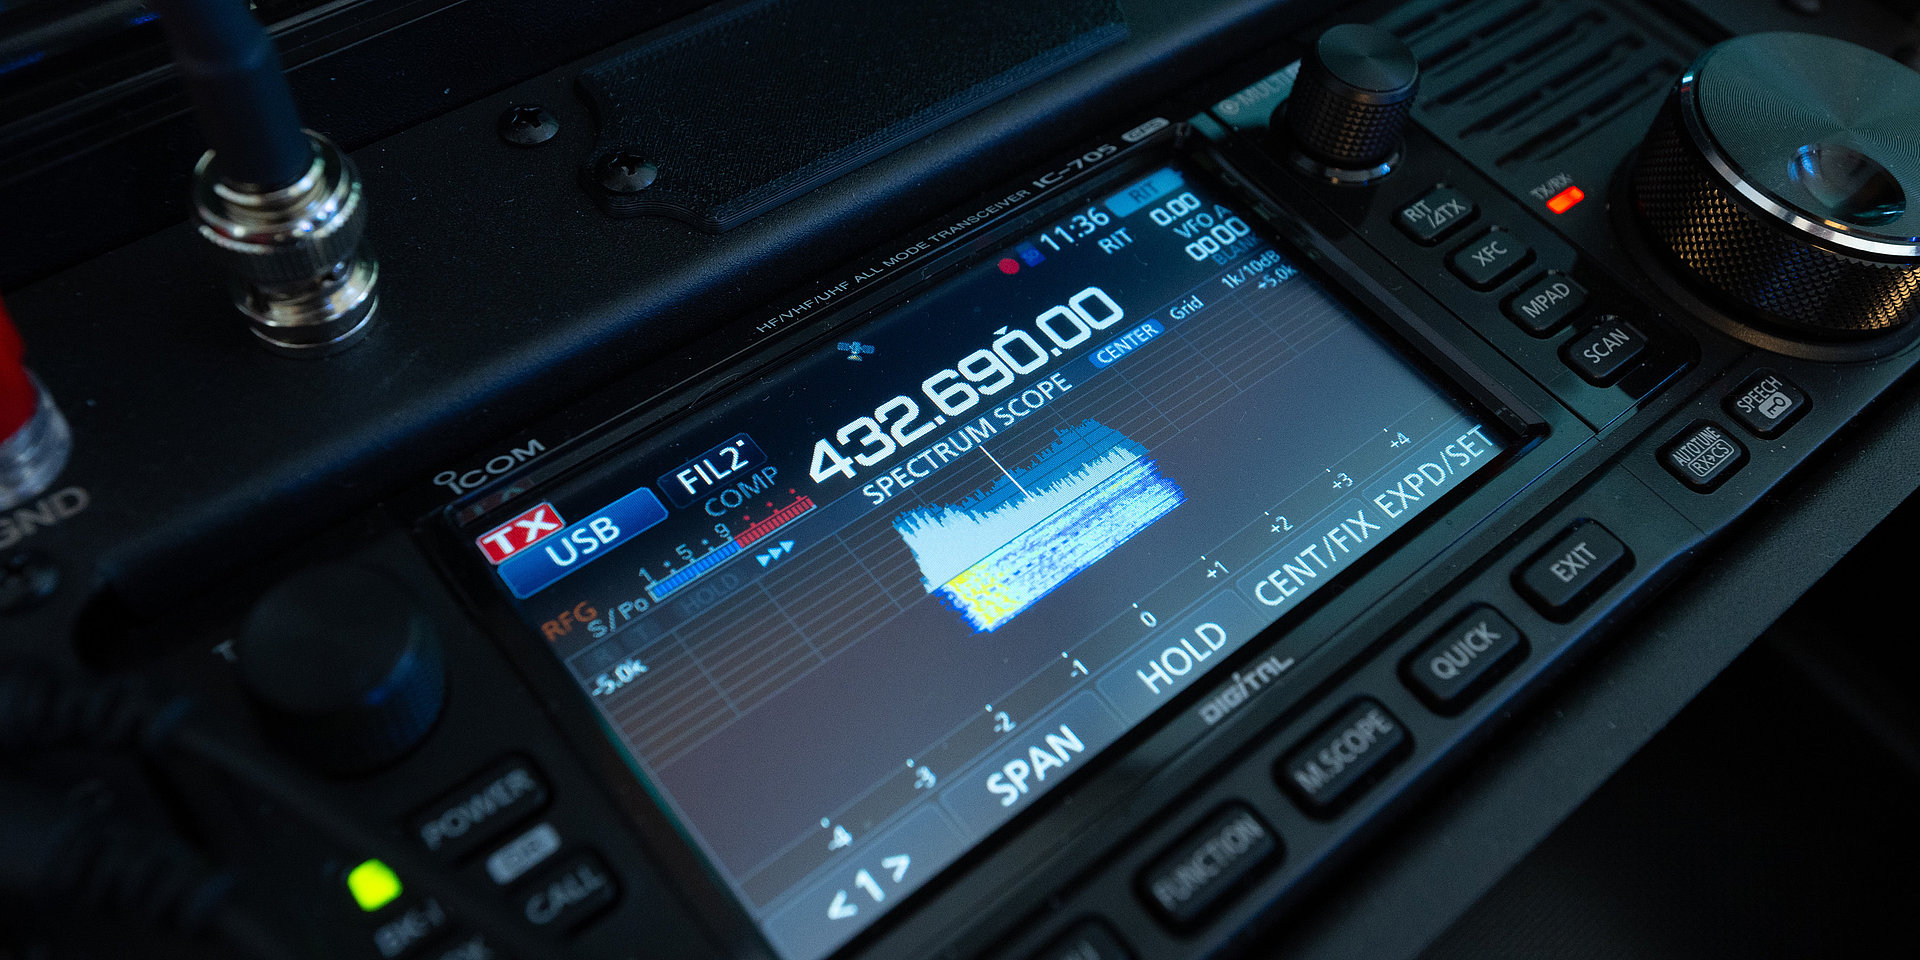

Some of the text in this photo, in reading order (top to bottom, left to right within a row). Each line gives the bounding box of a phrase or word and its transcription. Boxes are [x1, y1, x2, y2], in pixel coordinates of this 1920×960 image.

[1128, 181, 1161, 204] RIT
[1402, 199, 1433, 223] RIT
[756, 143, 1118, 333] HF/VHF/UHF ALL MODE TRANSCEIVER IC-705
[1040, 206, 1110, 251] 11:36
[1098, 192, 1201, 255] RIT 0.00
[1173, 204, 1232, 239] VFO A
[1211, 232, 1261, 266] BLANK
[1221, 249, 1281, 289] 1k/10dB
[1471, 240, 1508, 267] XFC
[1169, 295, 1204, 322] Grid
[1521, 282, 1571, 319] MPAD
[1095, 322, 1159, 365] CENTER
[1583, 327, 1630, 364] SCAN
[809, 287, 1124, 484] 432.690.00
[1736, 375, 1783, 413] SPEECH
[862, 372, 1073, 505] SPECTRUM SCOPE
[1671, 426, 1721, 467] AUTOTUNE
[704, 465, 778, 517] COMP
[1373, 424, 1494, 519] EXPD/SET
[482, 509, 560, 555] TX
[544, 517, 620, 567] USB
[1071, 659, 1089, 677] -1
[1140, 611, 1158, 628] 0
[1206, 560, 1229, 579] +1
[1271, 516, 1293, 533] +2
[1333, 472, 1353, 489] +3
[1390, 432, 1412, 448] +4
[1254, 509, 1381, 606] CENT/FIX
[1550, 541, 1597, 584] EXIT
[541, 601, 598, 642] RFG
[1136, 622, 1227, 694] HOLD
[1430, 620, 1501, 681] QUICK
[987, 723, 1085, 806] SPAN
[1294, 708, 1394, 795] M.SCOPE
